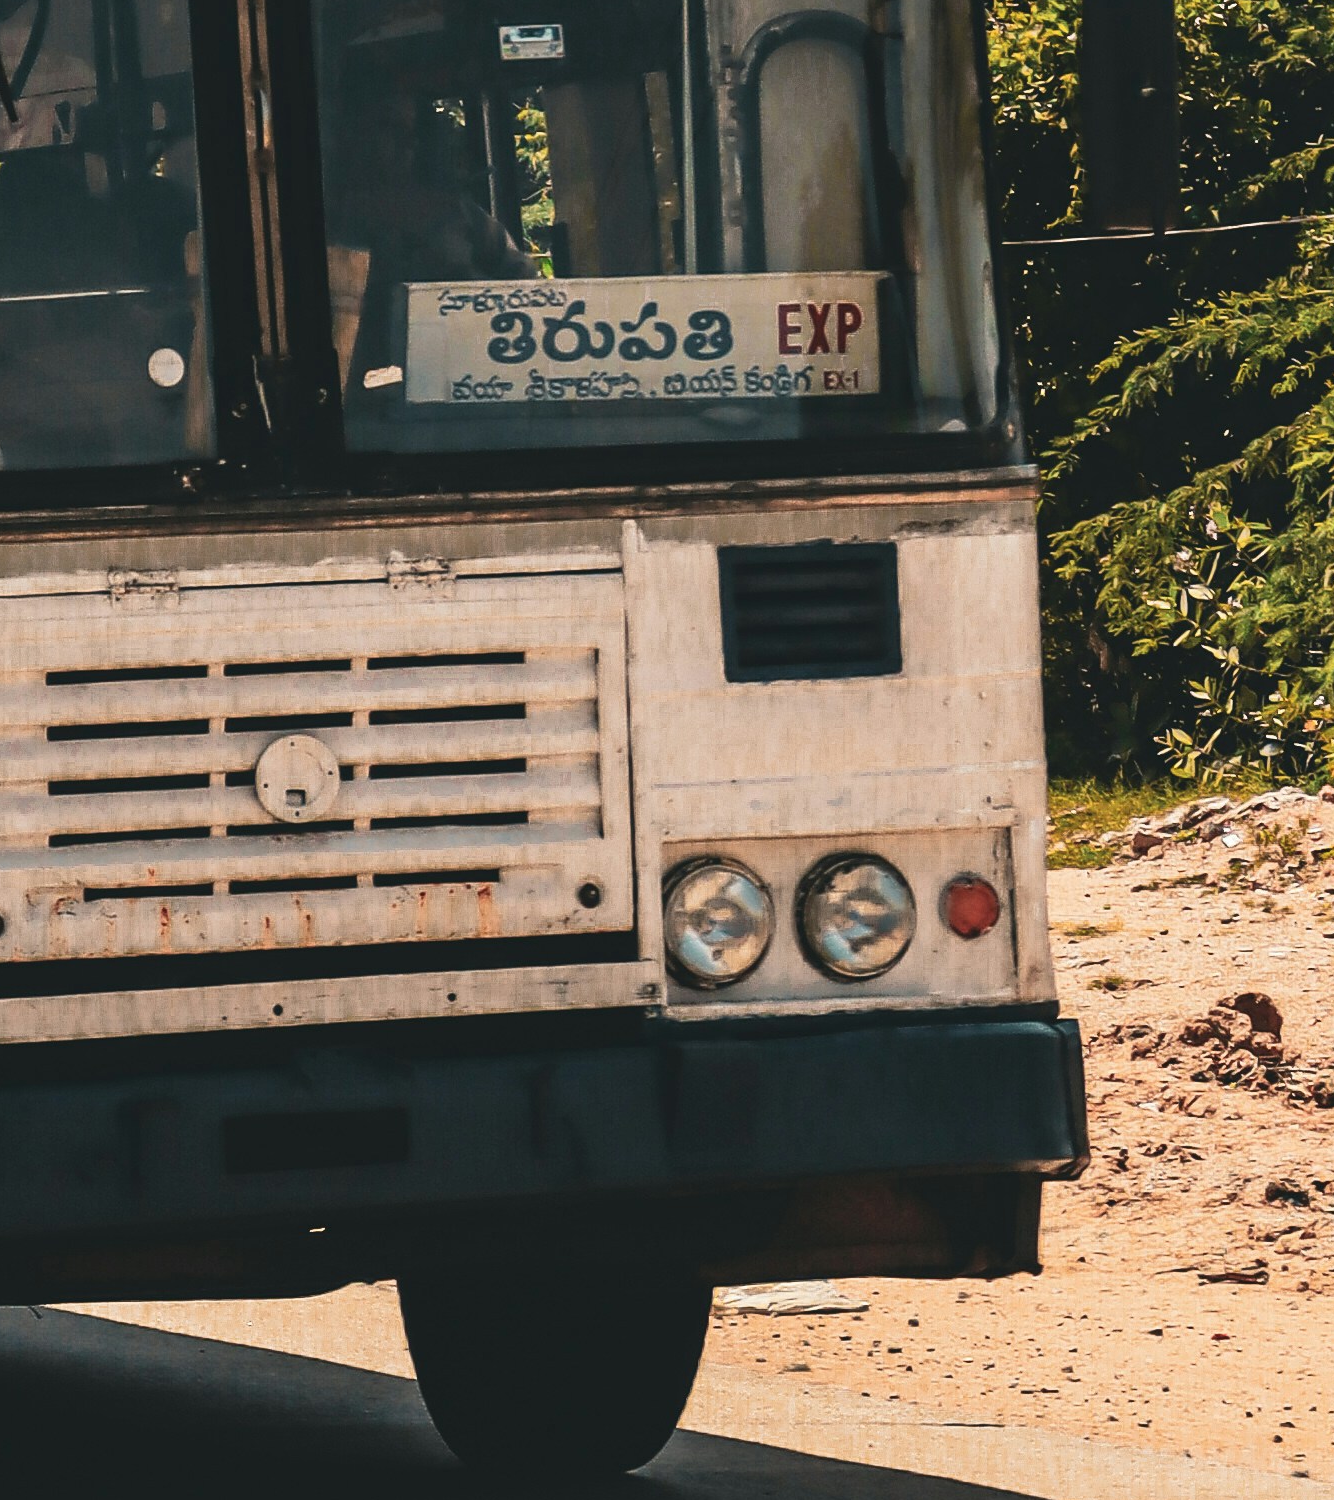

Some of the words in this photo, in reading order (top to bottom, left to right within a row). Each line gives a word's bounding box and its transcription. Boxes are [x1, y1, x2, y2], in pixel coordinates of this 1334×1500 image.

[486, 300, 734, 364] తిరుపతి
[776, 302, 863, 356] EXP
[451, 373, 514, 400] వయా
